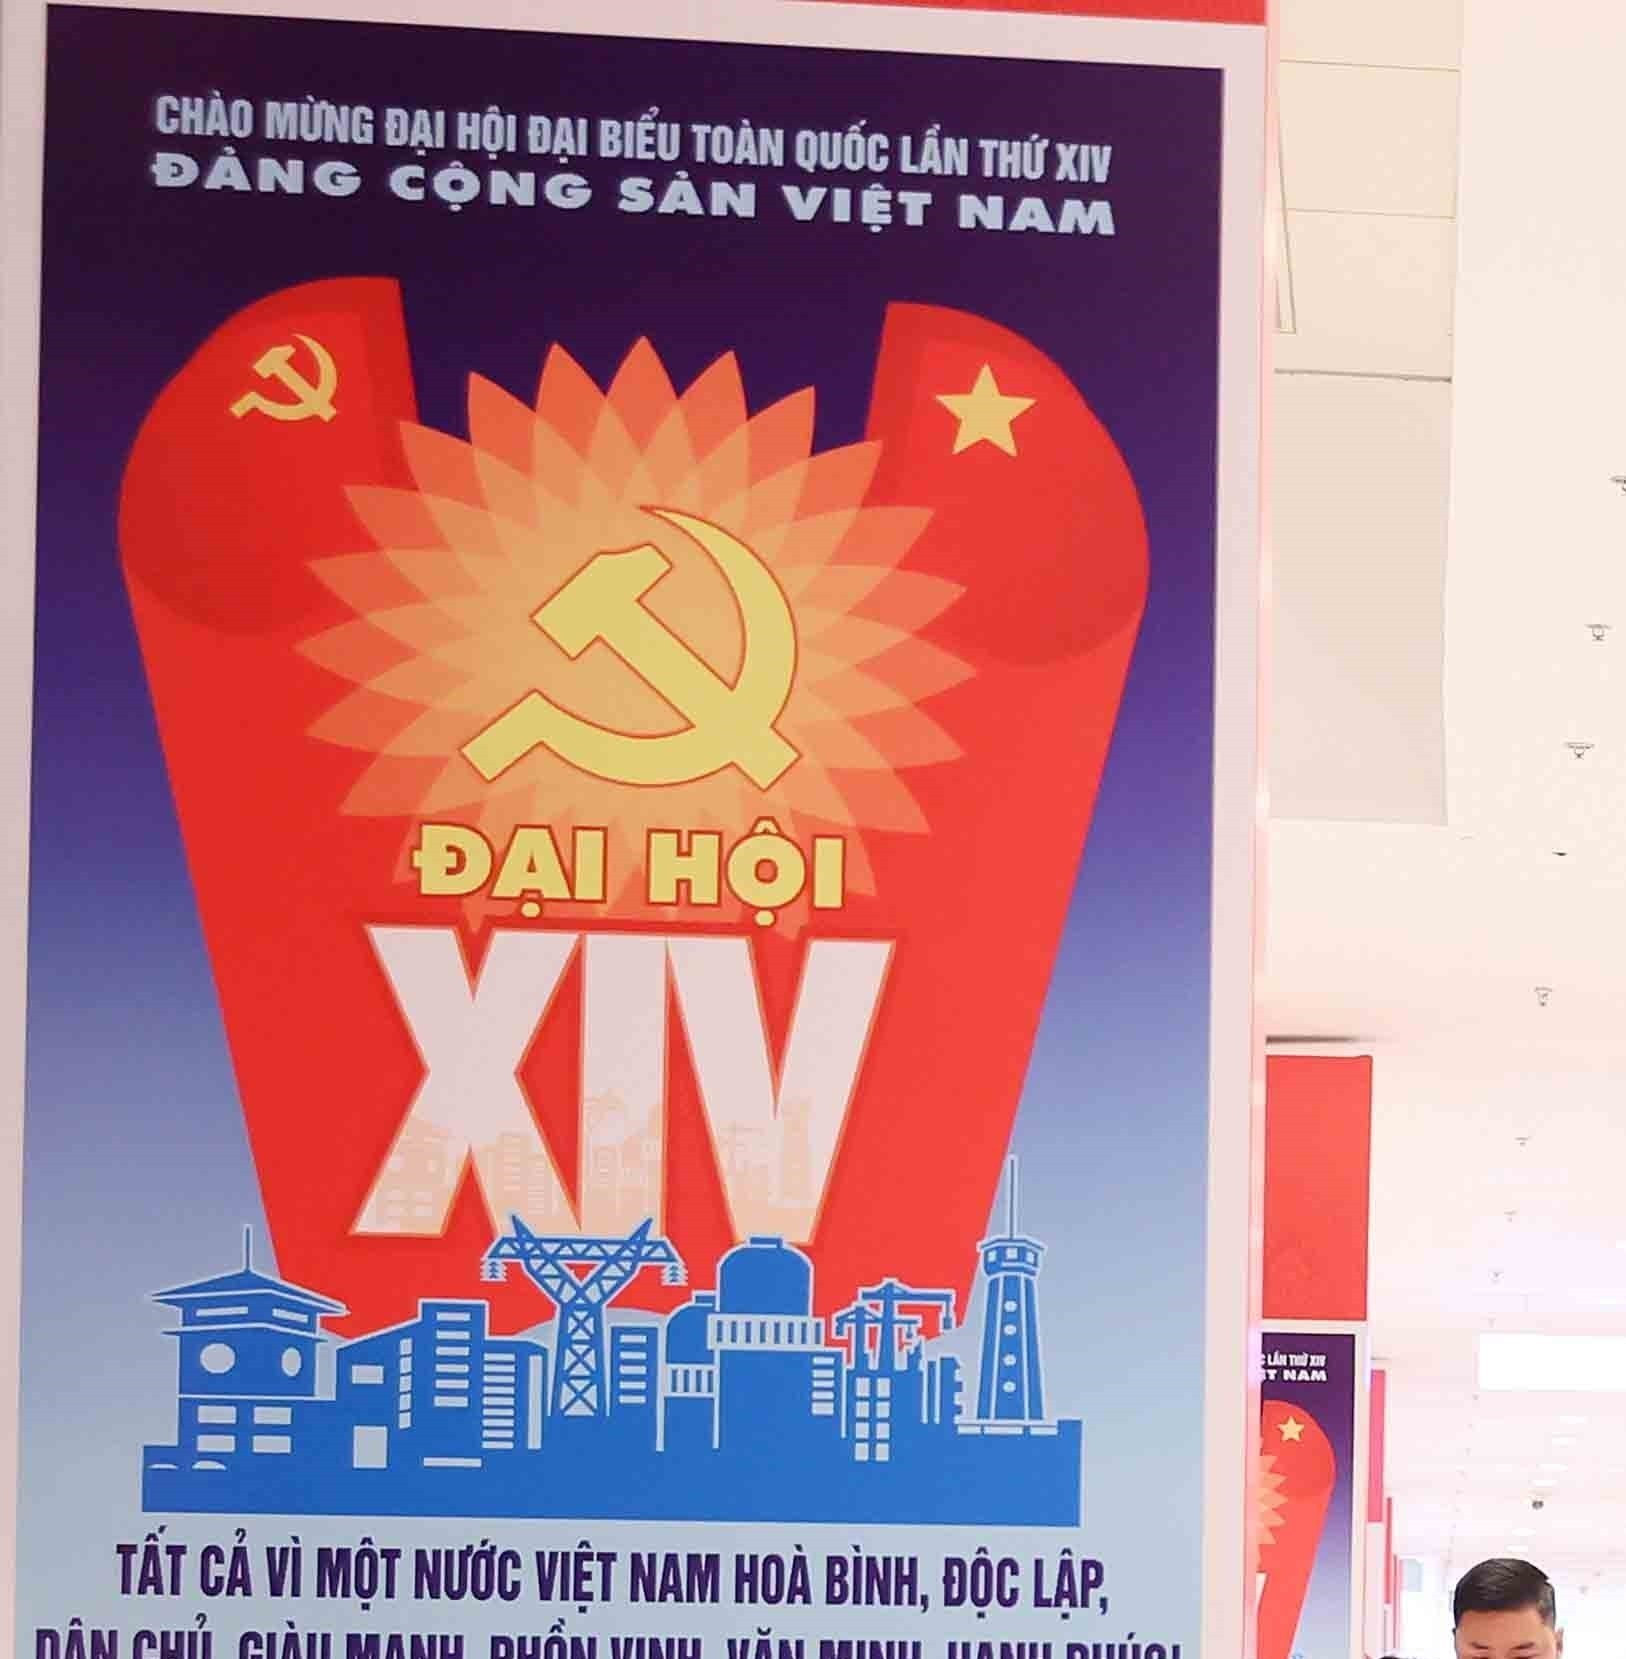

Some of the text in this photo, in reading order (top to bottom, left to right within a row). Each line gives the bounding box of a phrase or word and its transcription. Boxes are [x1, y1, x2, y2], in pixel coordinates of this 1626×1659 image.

[155, 88, 1113, 184] CHÀO MỪNG ĐẠI HỘI ĐẠI BIỂU TOÀN QUỐC LẦN THỨ XIV
[151, 145, 1116, 237] ĐẢNG CỘNG SẢN VIỆT NAM
[410, 815, 847, 929] ĐẠI HỘI
[348, 922, 898, 1248] XIV
[1282, 1368, 1328, 1382] NAM
[115, 1524, 1110, 1621] TẤT CẢ VÌ MỘT NƯỚC VIỆT NAM HOÀ BÌNH, ĐỘC LẬP,
